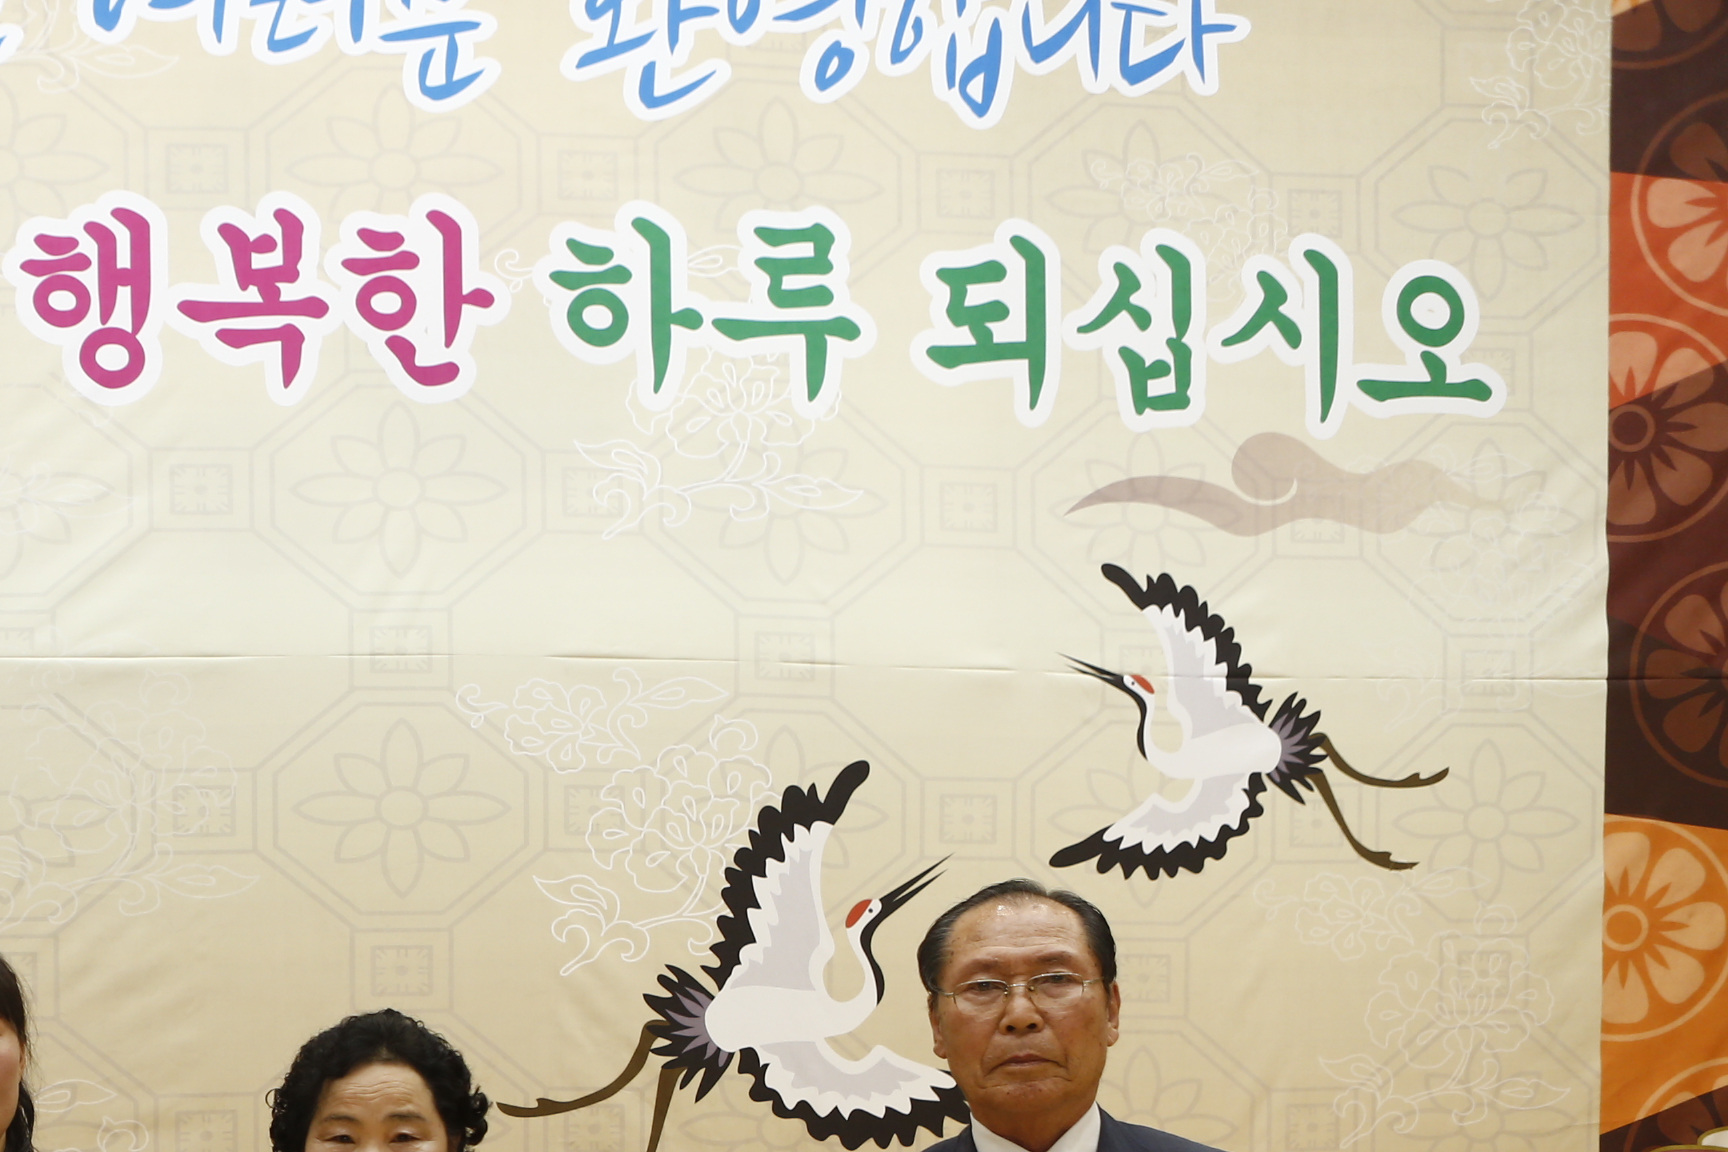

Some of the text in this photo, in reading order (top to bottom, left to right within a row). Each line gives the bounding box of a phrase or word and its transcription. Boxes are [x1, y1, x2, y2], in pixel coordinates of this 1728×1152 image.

[20, 207, 496, 390] 행복한
[550, 216, 861, 401] 하루
[927, 234, 1493, 422] 되십시오
